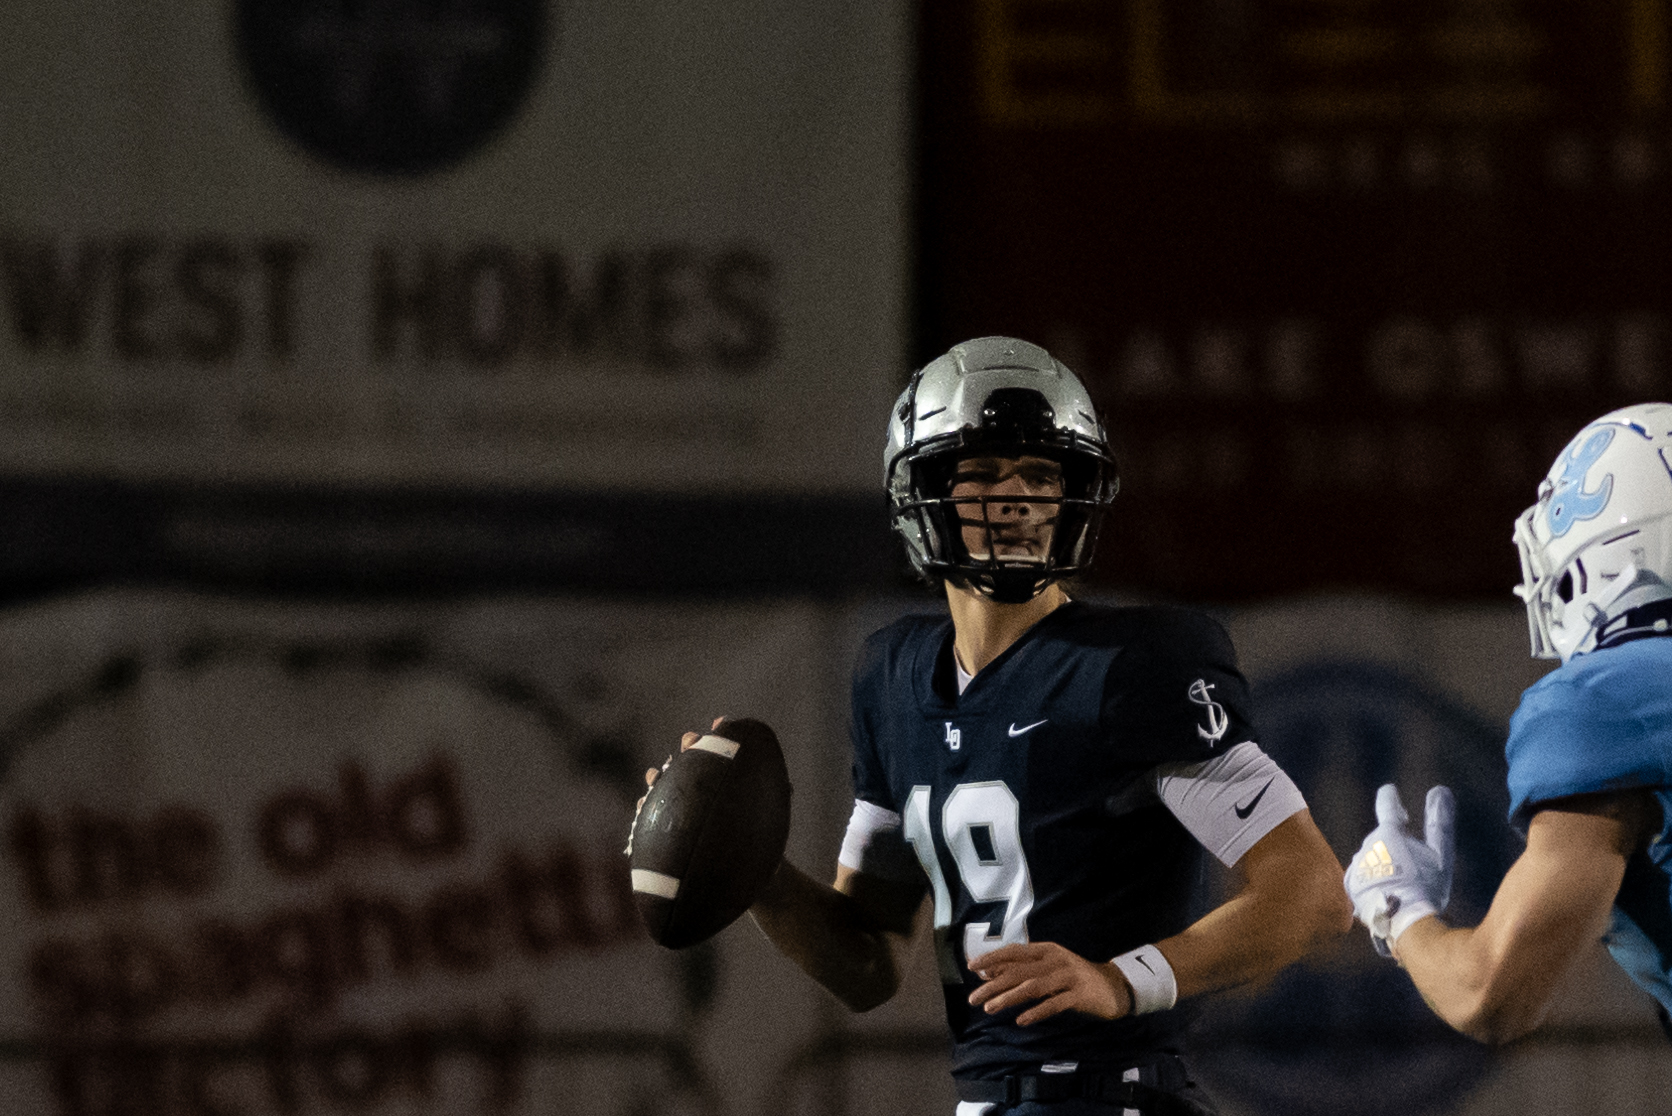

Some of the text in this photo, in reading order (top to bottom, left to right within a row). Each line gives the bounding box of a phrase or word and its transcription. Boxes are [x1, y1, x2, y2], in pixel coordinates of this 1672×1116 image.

[368, 240, 780, 373] HOMES
[10, 752, 467, 912] the old
[904, 779, 1035, 975] 19
